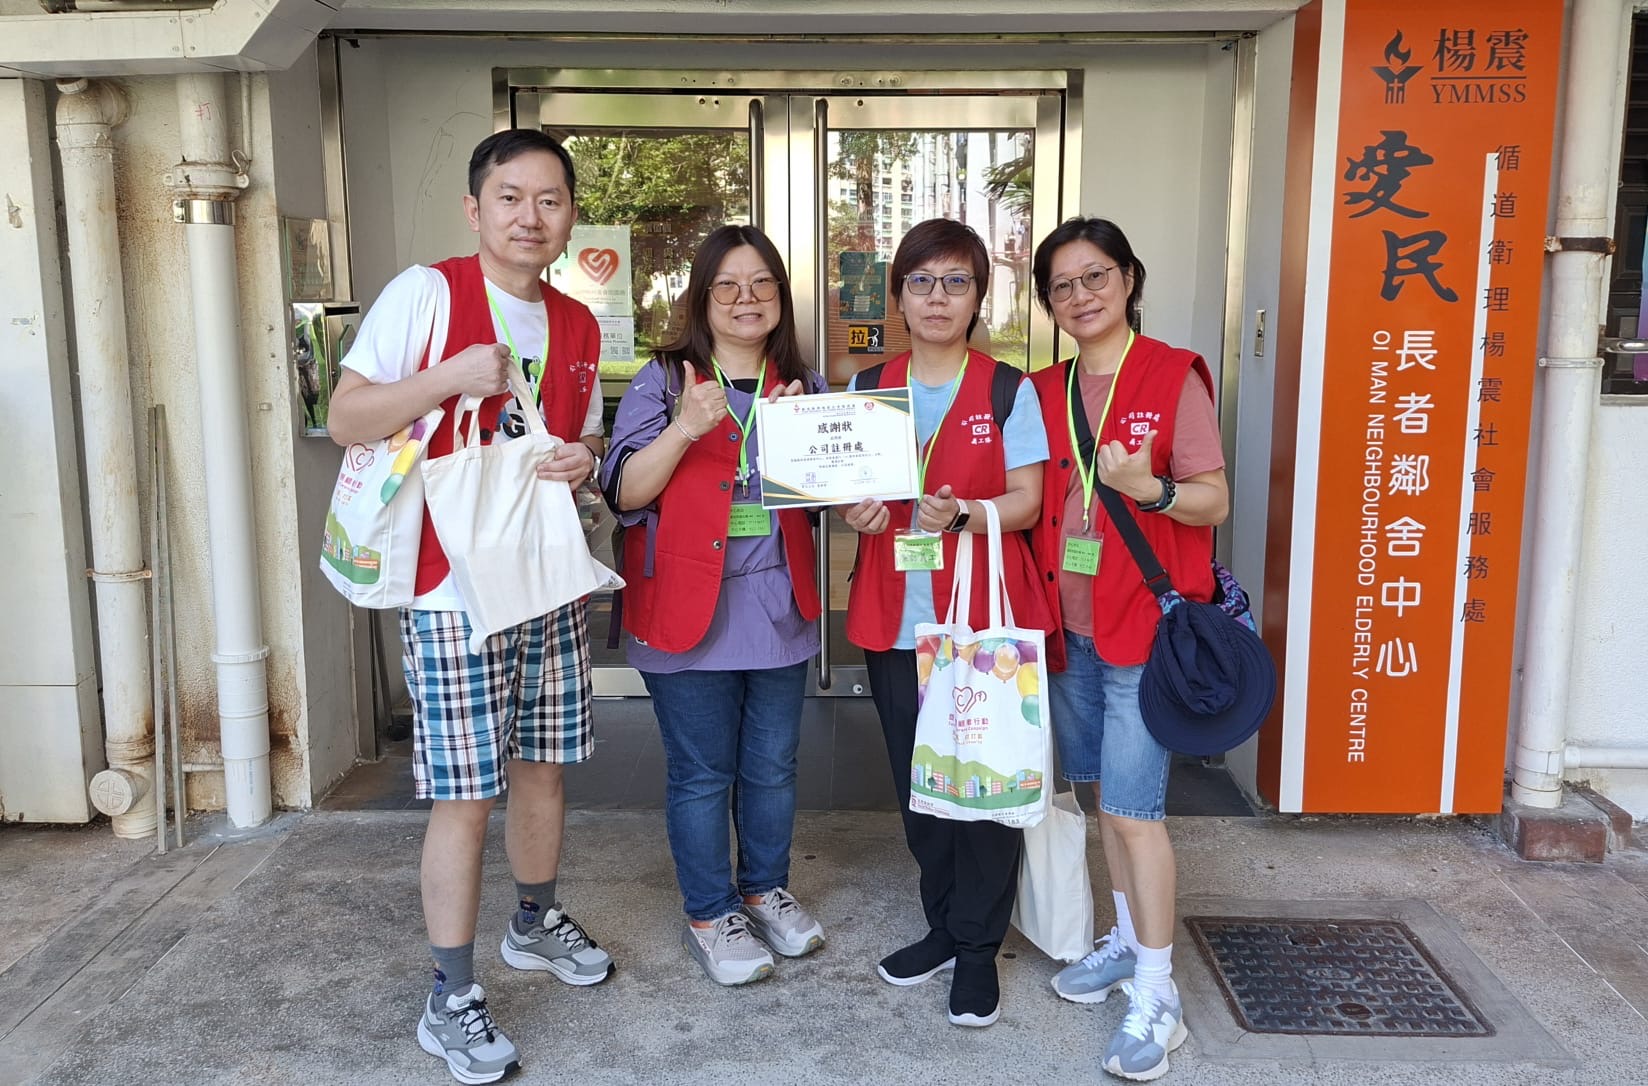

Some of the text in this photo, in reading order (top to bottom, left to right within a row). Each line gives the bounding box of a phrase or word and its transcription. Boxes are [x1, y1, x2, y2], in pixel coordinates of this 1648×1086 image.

[1432, 28, 1529, 73] 楊震
[1431, 83, 1527, 104] YMMSS
[1460, 144, 1521, 624] 循道衛理楊震社會服務處
[808, 441, 864, 455] 公司註冊處
[817, 420, 853, 434] 感謝狀
[1375, 330, 1438, 677] 長者鄰舍中心
[1347, 330, 1391, 763] OI MAN NEIGHBOURHOOD ELDERLY CENTRE
